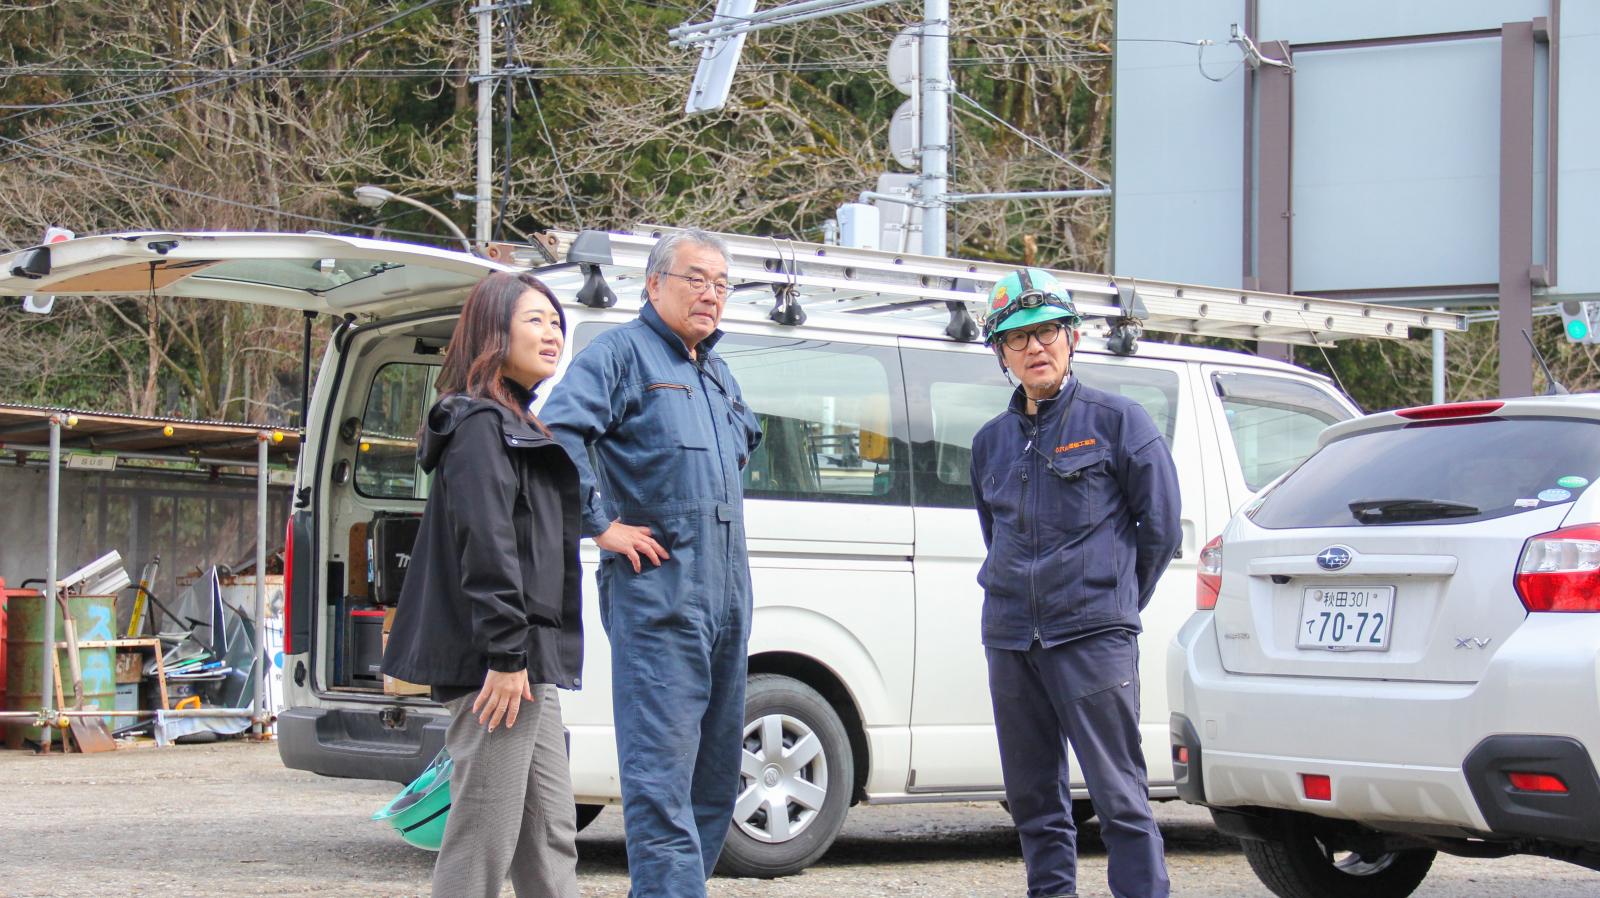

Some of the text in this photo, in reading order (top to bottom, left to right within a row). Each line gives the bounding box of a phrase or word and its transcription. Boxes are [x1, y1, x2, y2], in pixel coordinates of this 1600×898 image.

[1306, 612, 1384, 643] て 70-72
[1455, 637, 1492, 650] XV
